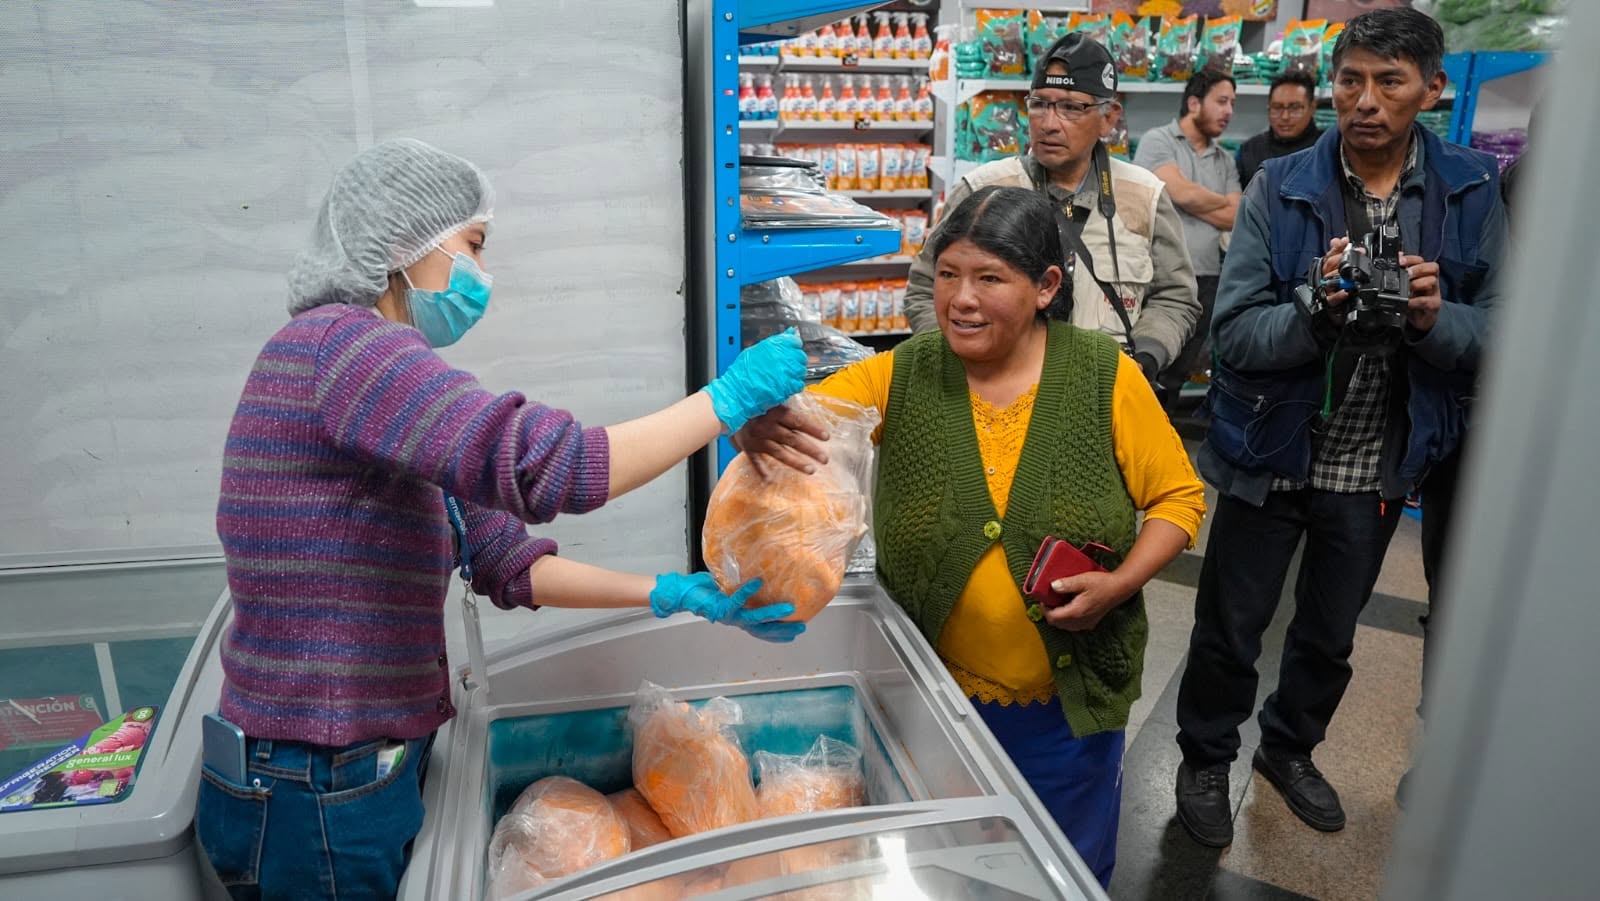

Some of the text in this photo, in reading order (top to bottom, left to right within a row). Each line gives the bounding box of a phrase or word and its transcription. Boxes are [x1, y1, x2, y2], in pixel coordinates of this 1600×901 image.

[1046, 76, 1075, 85] NIBOL
[66, 753, 132, 769] general lux
